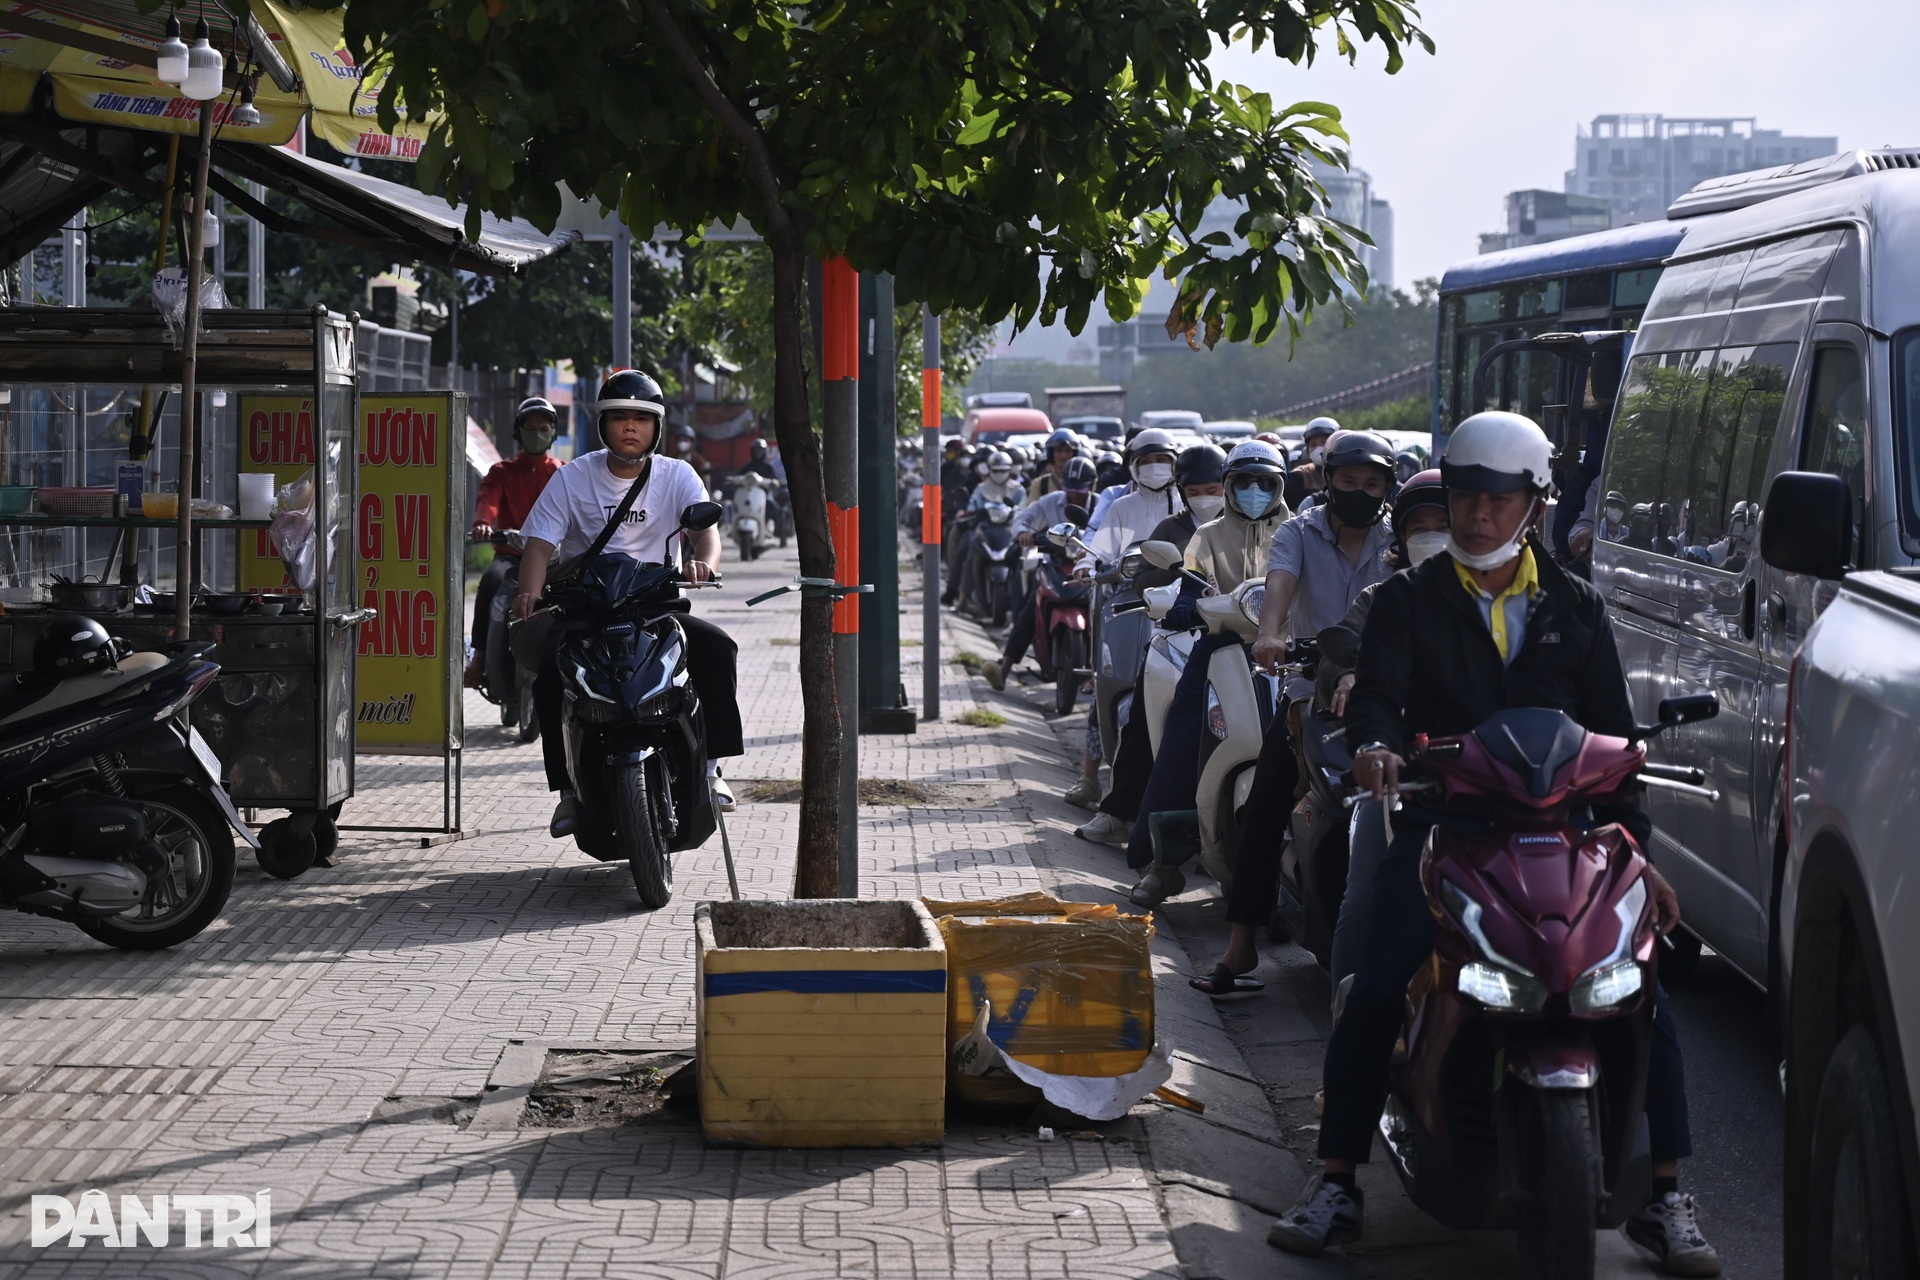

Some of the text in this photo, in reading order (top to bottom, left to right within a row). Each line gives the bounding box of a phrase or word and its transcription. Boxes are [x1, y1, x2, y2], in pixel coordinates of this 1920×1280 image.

[93, 92, 129, 111] TĂNG
[128, 97, 167, 116] THÊM
[356, 128, 421, 158] TỈNH TÁO
[249, 400, 437, 466] CHÁ ƯƠN
[394, 493, 430, 577] VỊ
[357, 692, 415, 724] mời!
[1519, 836, 1562, 844] HONDA
